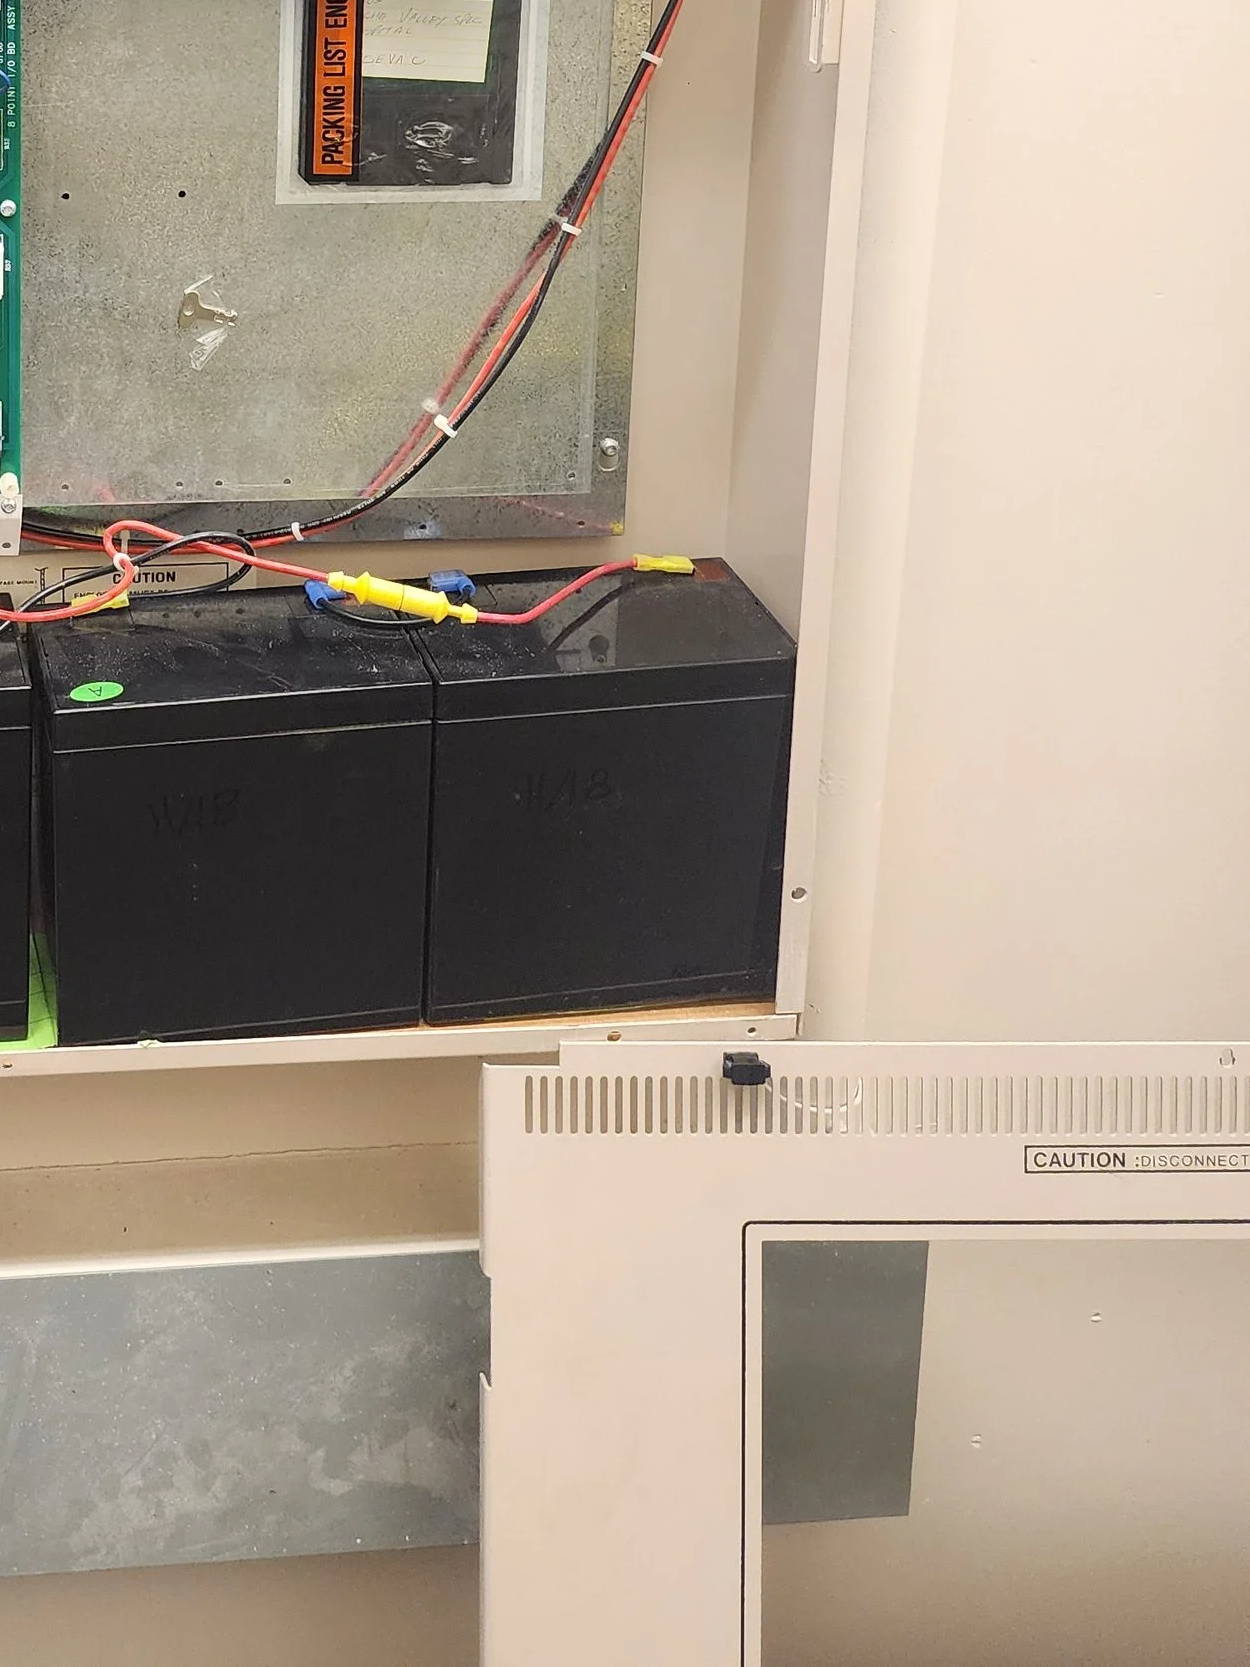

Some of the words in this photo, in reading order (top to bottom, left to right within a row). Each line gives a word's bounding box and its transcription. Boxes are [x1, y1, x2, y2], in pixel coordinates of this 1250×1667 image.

[7, 5, 16, 30] ASSY
[323, 37, 346, 78] LIST
[321, 84, 346, 166] PACKING
[112, 570, 176, 584] CUTION
[1033, 1151, 1126, 1168] CAUTION
